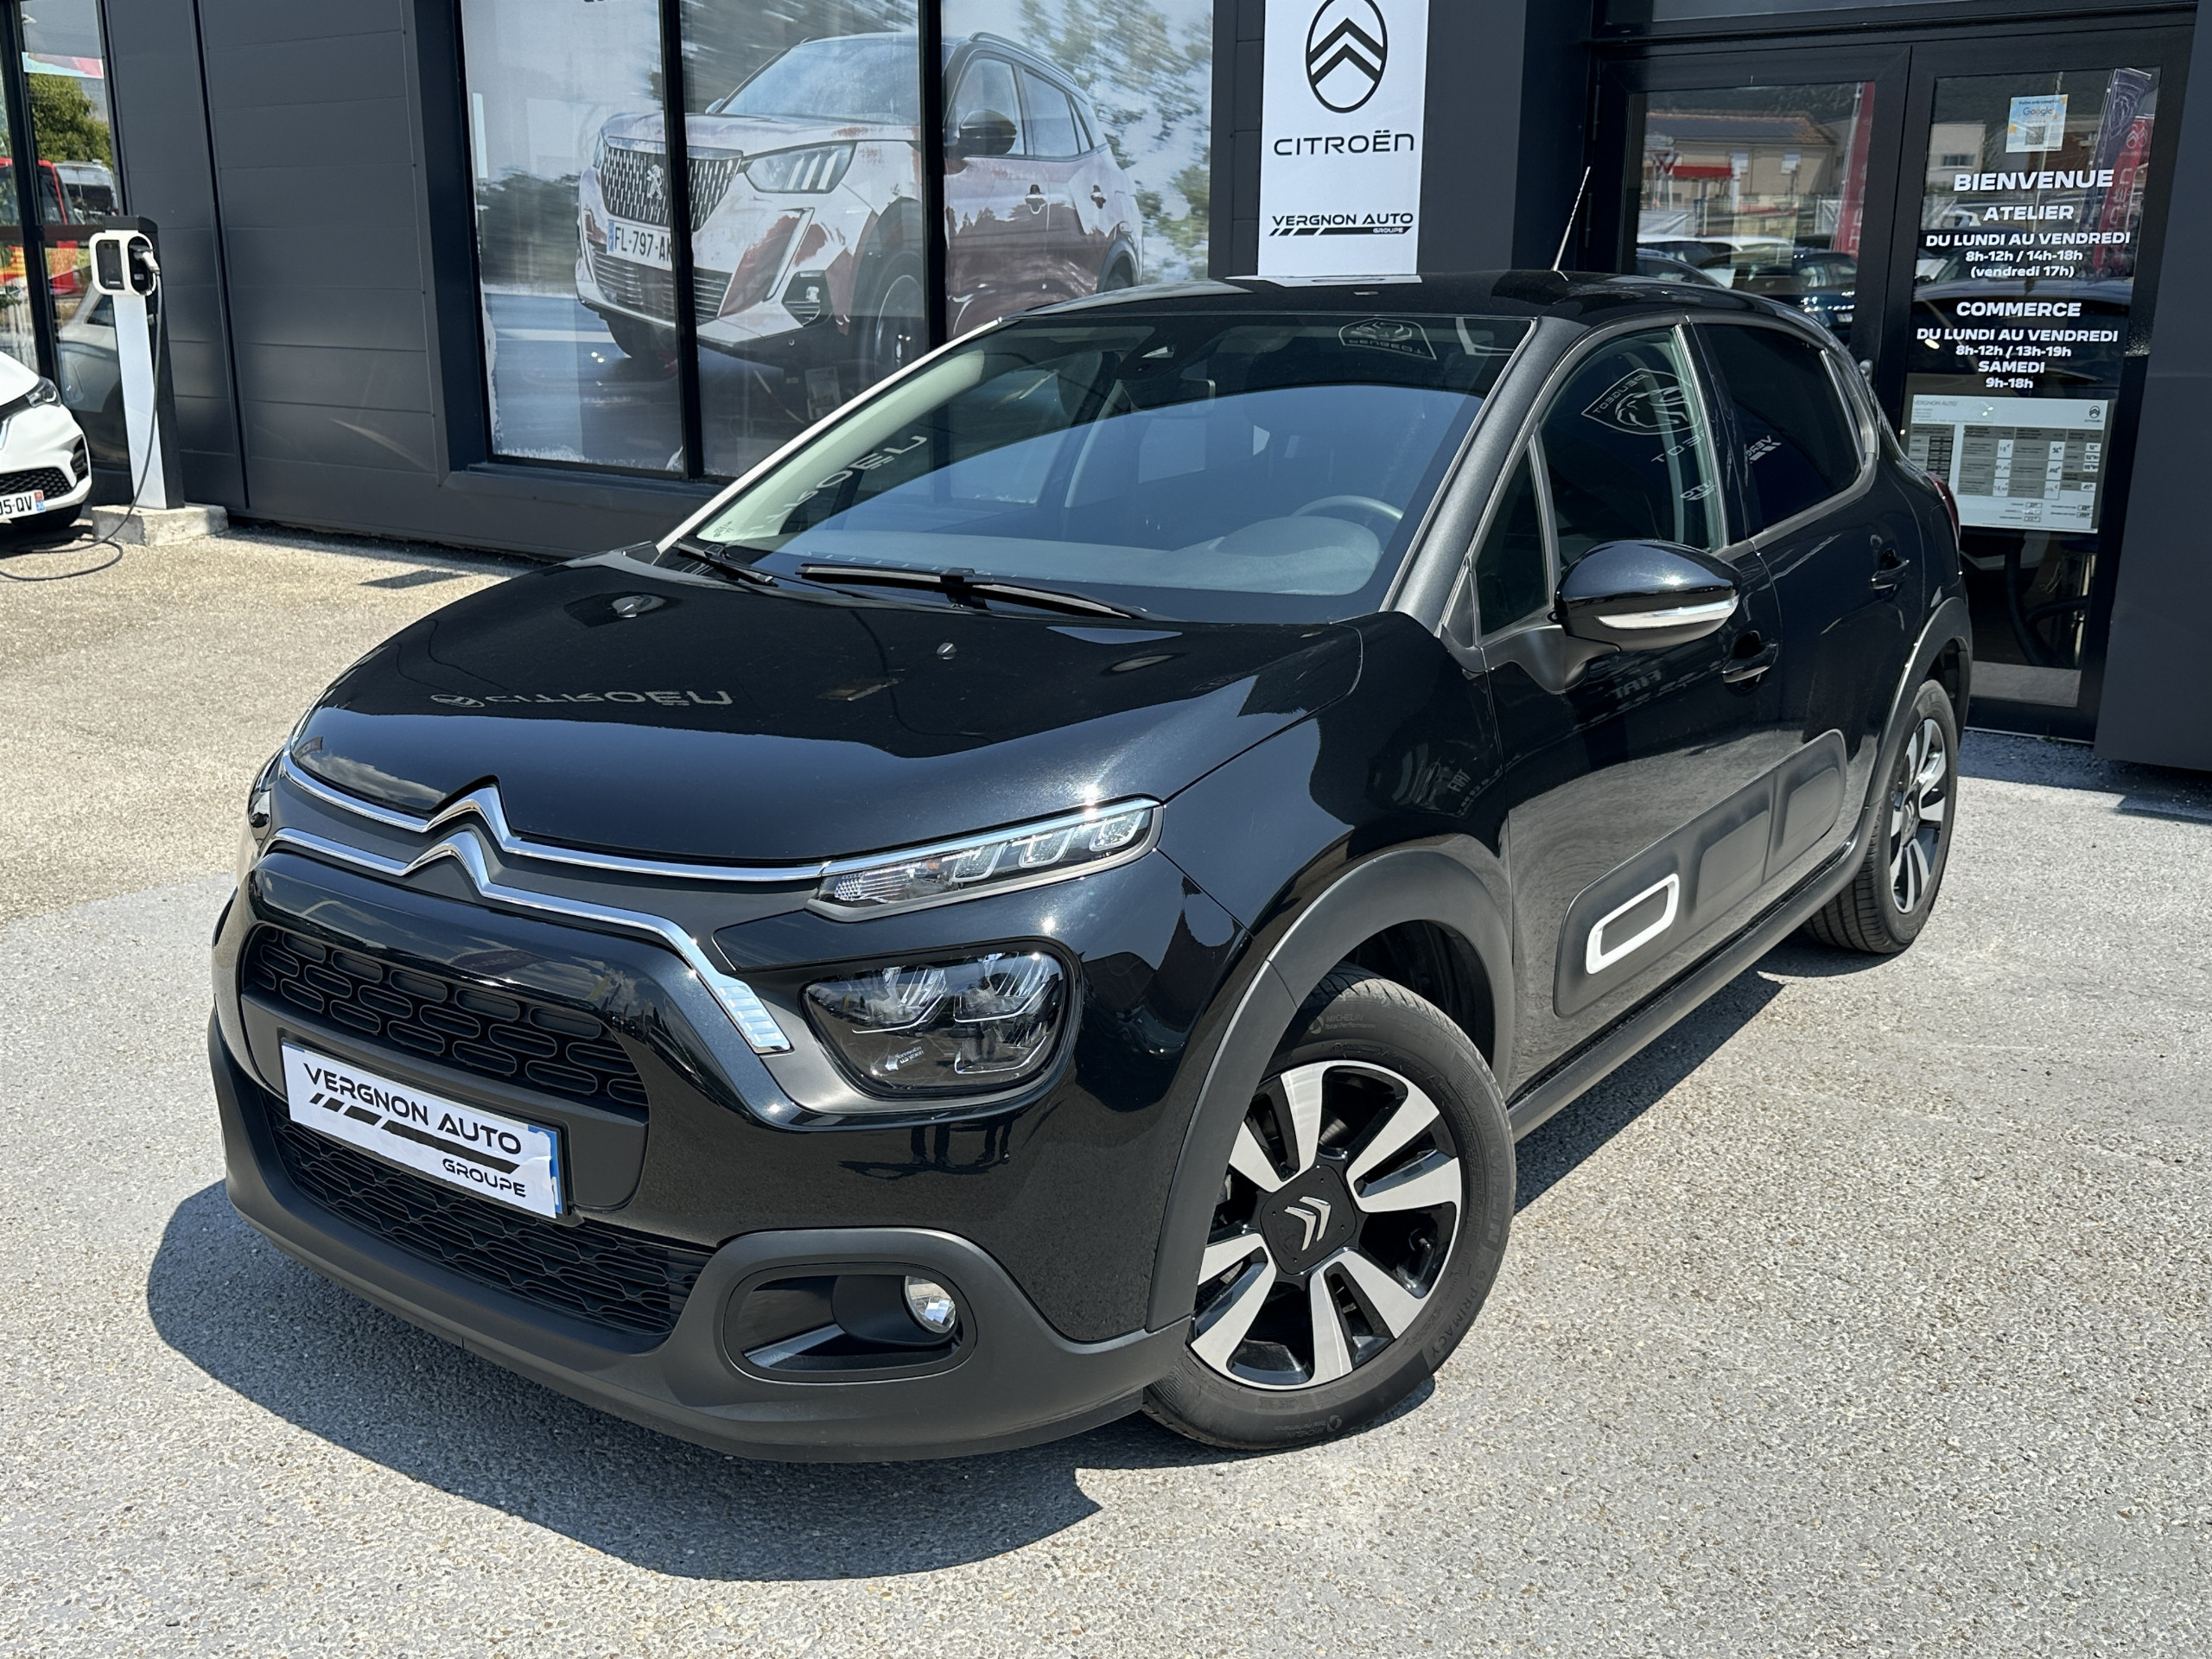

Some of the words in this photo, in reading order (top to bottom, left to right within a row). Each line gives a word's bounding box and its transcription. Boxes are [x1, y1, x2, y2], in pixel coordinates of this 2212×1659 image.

[2023, 107, 2053, 116] Google
[1954, 169, 2114, 192] BIENVENUE
[1272, 214, 1357, 226] VERGNON
[1362, 213, 1414, 226] AUTO
[1983, 205, 2075, 221] ATELIER
[1925, 234, 1951, 246] DU
[1954, 233, 2005, 246] LUNDI
[2008, 232, 2035, 245] AU
[2038, 232, 2131, 245] VENDREDI
[1965, 251, 2013, 262] 8h-12h
[2026, 250, 2083, 261] 14h-18h
[1970, 266, 2040, 278] (vendredi
[2043, 265, 2075, 277] 17h)
[1956, 302, 2082, 317] COMMERCE
[1916, 328, 1942, 340] DU
[1944, 328, 1994, 340] LUNDI
[1998, 329, 2024, 340] AU
[2028, 329, 2119, 342] VENDREDI
[1955, 346, 2003, 356] 8h-12h
[2016, 346, 2072, 357] 13h-19h
[1978, 360, 2045, 373] SAMEDI
[1986, 378, 2033, 389] 9h-18h
[1325, 1013, 1363, 1023] MICHELIN
[303, 1063, 429, 1126] VERGNON
[437, 1113, 522, 1155] AUTO
[442, 1158, 527, 1198] GROUPE
